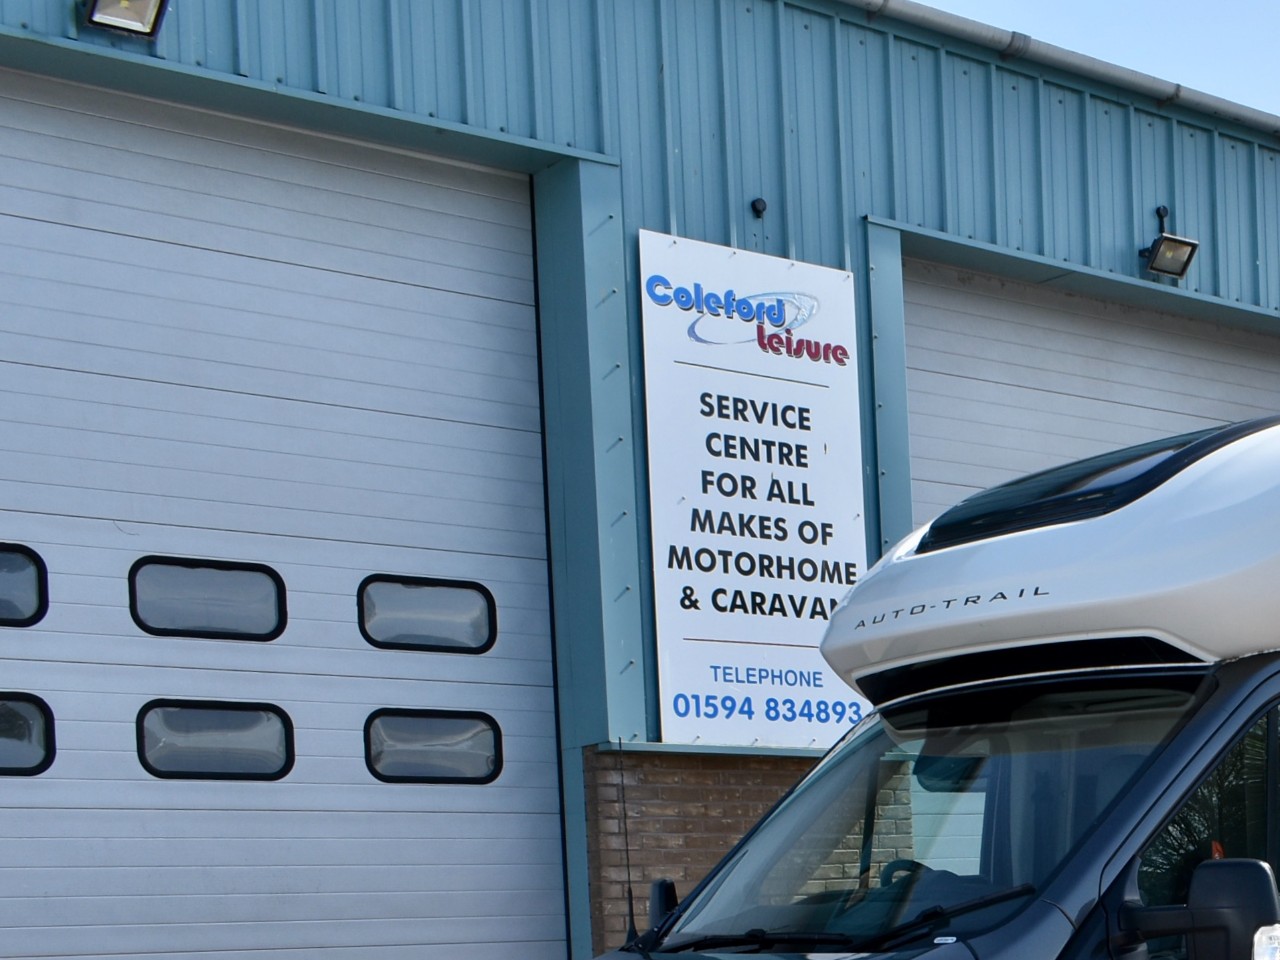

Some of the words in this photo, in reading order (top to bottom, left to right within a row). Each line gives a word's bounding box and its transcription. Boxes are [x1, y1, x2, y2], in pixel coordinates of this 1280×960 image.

[645, 274, 786, 327] Coleford
[699, 391, 811, 431] SERVICE
[705, 432, 809, 468] CENTRE
[701, 469, 758, 500] FOR
[766, 477, 816, 507] ALL
[690, 508, 788, 542] MAKES
[797, 520, 834, 546] OF
[667, 545, 858, 586] MOTORHOME
[680, 585, 701, 611] &
[854, 586, 1050, 630] AUTO-TRAIL
[709, 665, 824, 688] TELEPHONE
[673, 693, 755, 721] 01594
[765, 697, 863, 725] 834893
